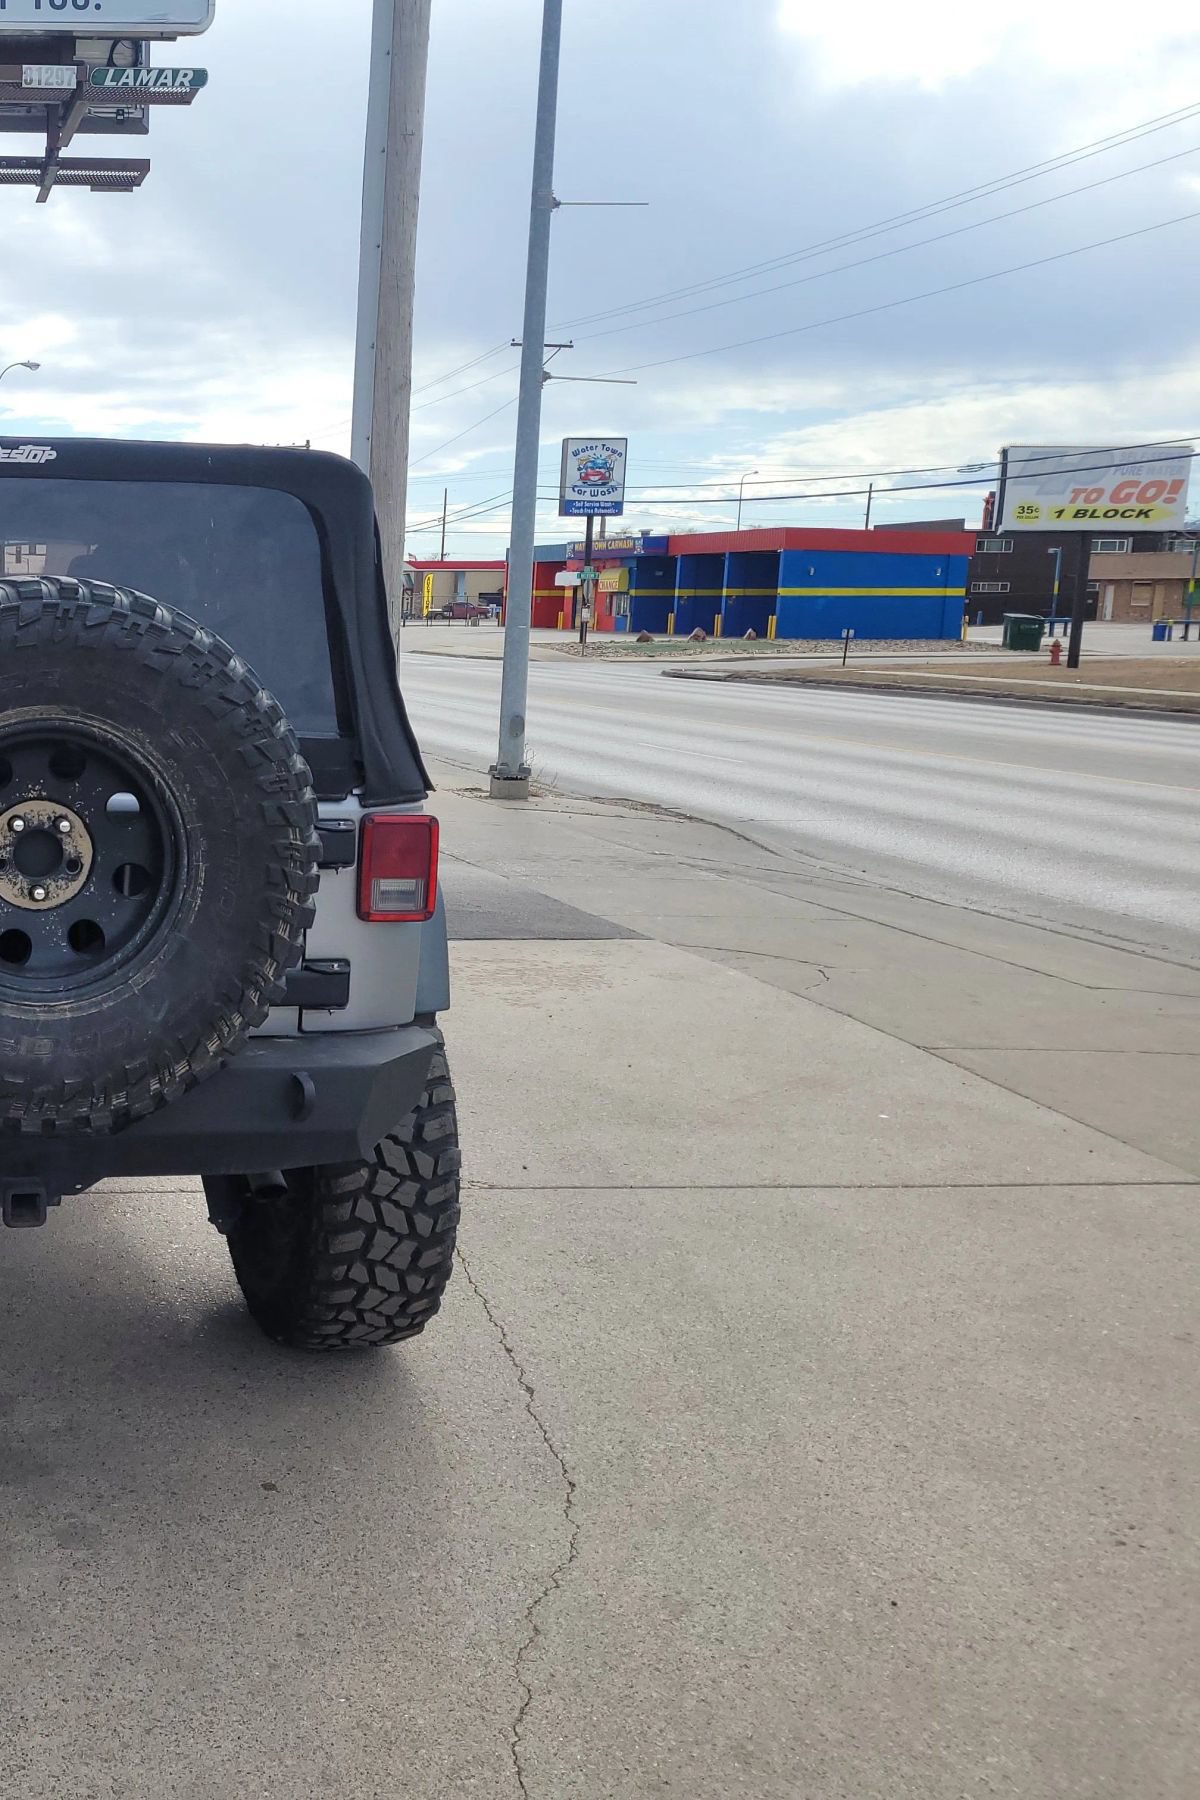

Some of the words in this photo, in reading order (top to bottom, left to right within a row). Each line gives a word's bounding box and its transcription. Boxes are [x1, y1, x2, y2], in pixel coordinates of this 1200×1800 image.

[104, 69, 194, 87] LAMAR
[572, 445, 599, 457] Water
[601, 444, 623, 458] Town
[1069, 487, 1104, 504] TO
[1109, 479, 1185, 504] GO!
[1054, 508, 1065, 518] 1
[1072, 508, 1154, 519] BLOCK
